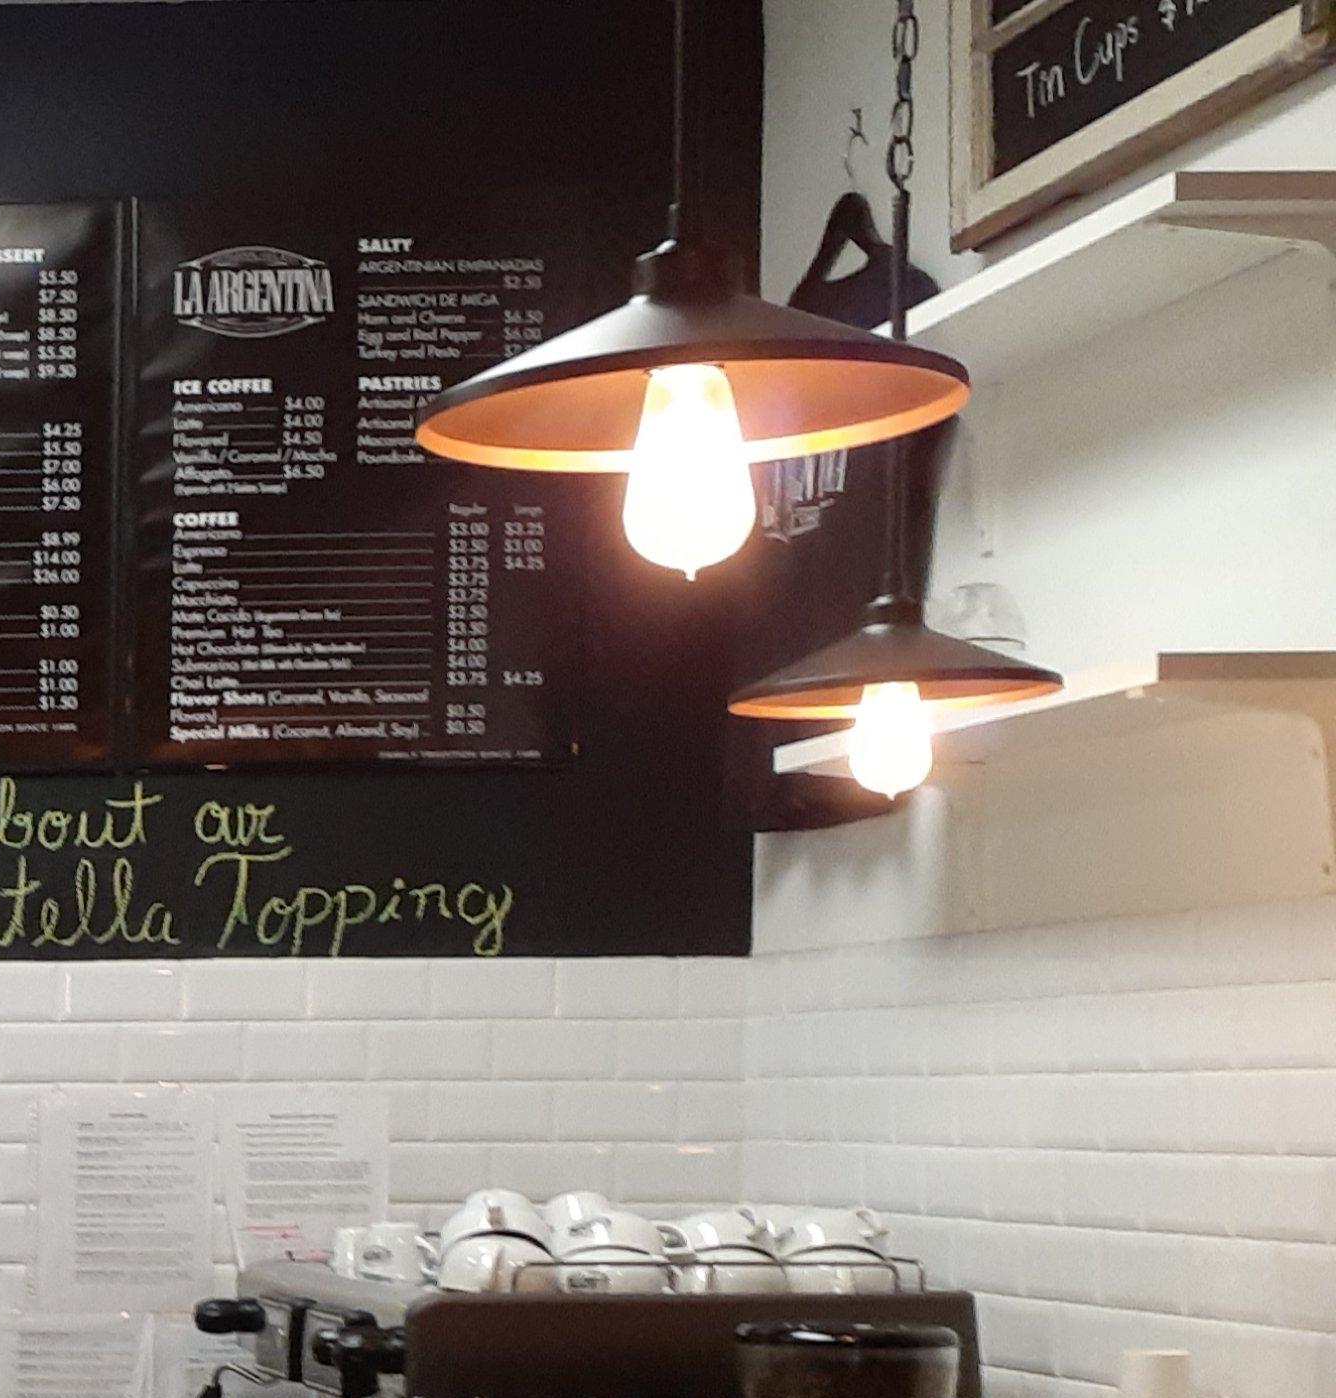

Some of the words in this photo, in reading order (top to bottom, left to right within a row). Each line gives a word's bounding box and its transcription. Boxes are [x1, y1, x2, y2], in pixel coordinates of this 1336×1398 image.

[1016, 61, 1065, 118] Tin
[1074, 16, 1138, 85] Cups
[358, 238, 412, 253] SALTY
[173, 271, 202, 315] LA
[207, 269, 335, 314] ARGENTINA
[173, 379, 202, 395] ICE
[207, 378, 273, 394] COFFEE
[357, 375, 442, 391] PASTRIES
[172, 511, 239, 527] COFFEE
[194, 845, 515, 956] Topping
